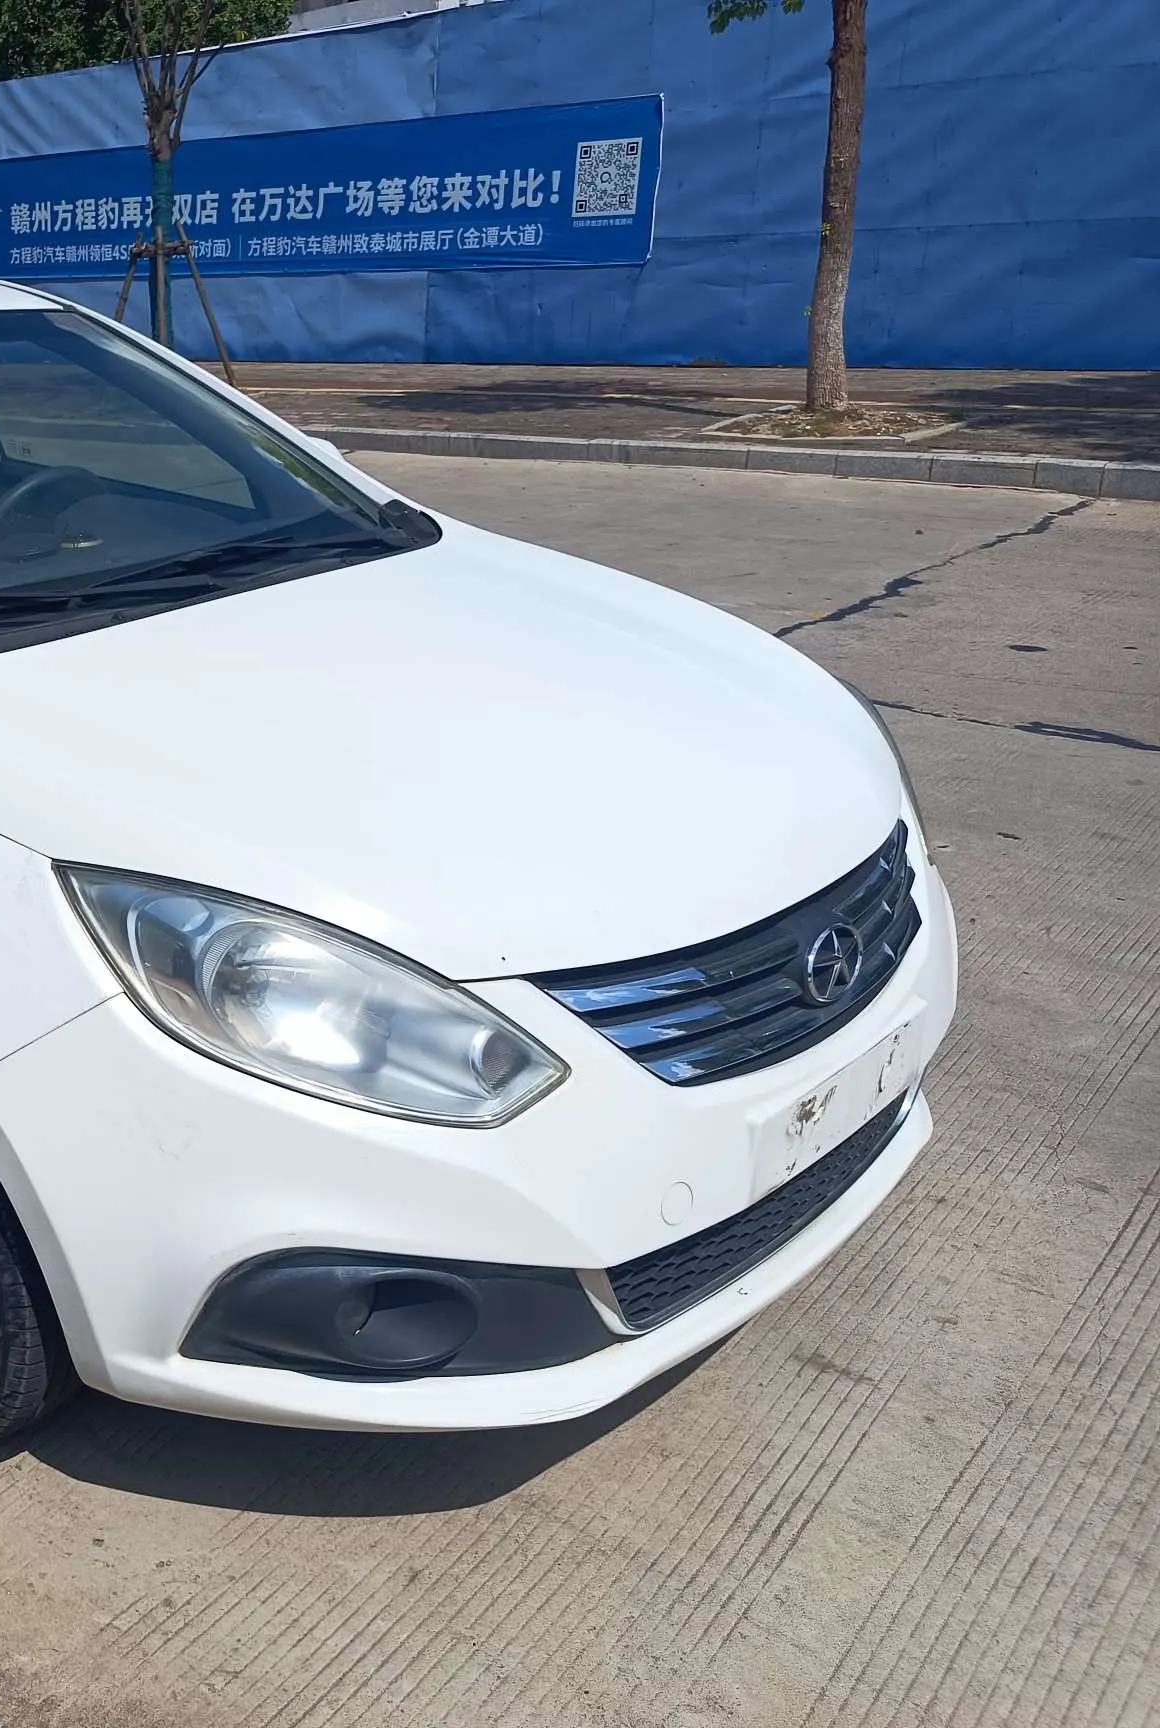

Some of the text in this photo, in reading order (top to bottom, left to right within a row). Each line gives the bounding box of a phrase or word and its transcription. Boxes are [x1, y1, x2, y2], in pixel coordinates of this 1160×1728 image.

[231, 168, 562, 223] 在万达广场等您来对比！
